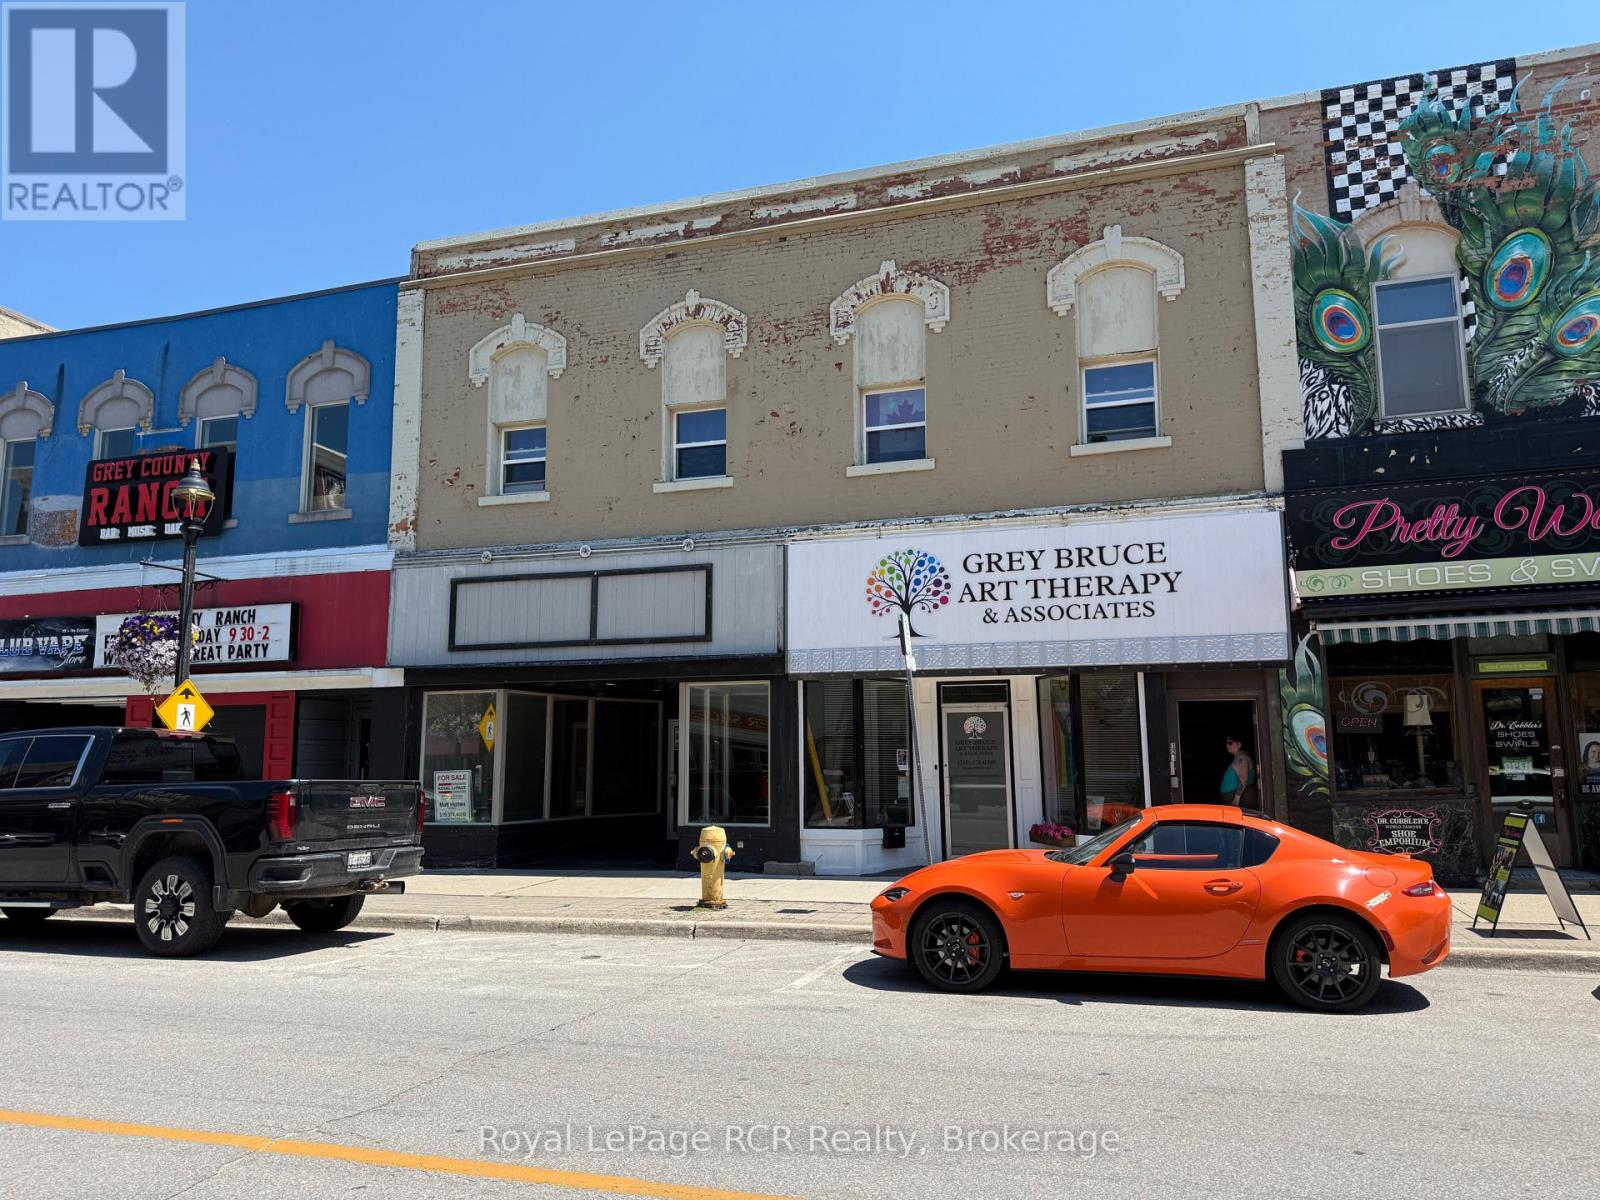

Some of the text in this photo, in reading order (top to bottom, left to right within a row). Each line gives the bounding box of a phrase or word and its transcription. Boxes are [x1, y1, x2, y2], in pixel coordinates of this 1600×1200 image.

[93, 452, 210, 482] GREY COUNTY
[100, 528, 120, 540] BAR
[128, 525, 157, 537] MUSIC
[1331, 498, 1484, 557] Pretty
[962, 541, 1167, 575] GREY BRUCE
[1361, 563, 1491, 590] SHOES
[1510, 558, 1538, 583] &
[958, 571, 1183, 603] ART THERAPY
[216, 609, 256, 625] RANCH
[982, 600, 1156, 624] & ASSOCIATES
[199, 628, 220, 643] DAY
[229, 627, 237, 641] 9
[36, 635, 89, 655] VAPE
[192, 643, 269, 661] REAT PARTY
[53, 650, 87, 668] Store
[1341, 717, 1377, 728] OPEN
[1490, 721, 1543, 730] Dr. Cobbler's
[1497, 731, 1536, 739] SHOES
[1495, 740, 1540, 748] SWIRLS
[349, 796, 386, 808] GMC
[1390, 817, 1429, 825] COBBLER'S
[1391, 830, 1417, 838] SHOE
[1378, 837, 1431, 848] EMPORIUM
